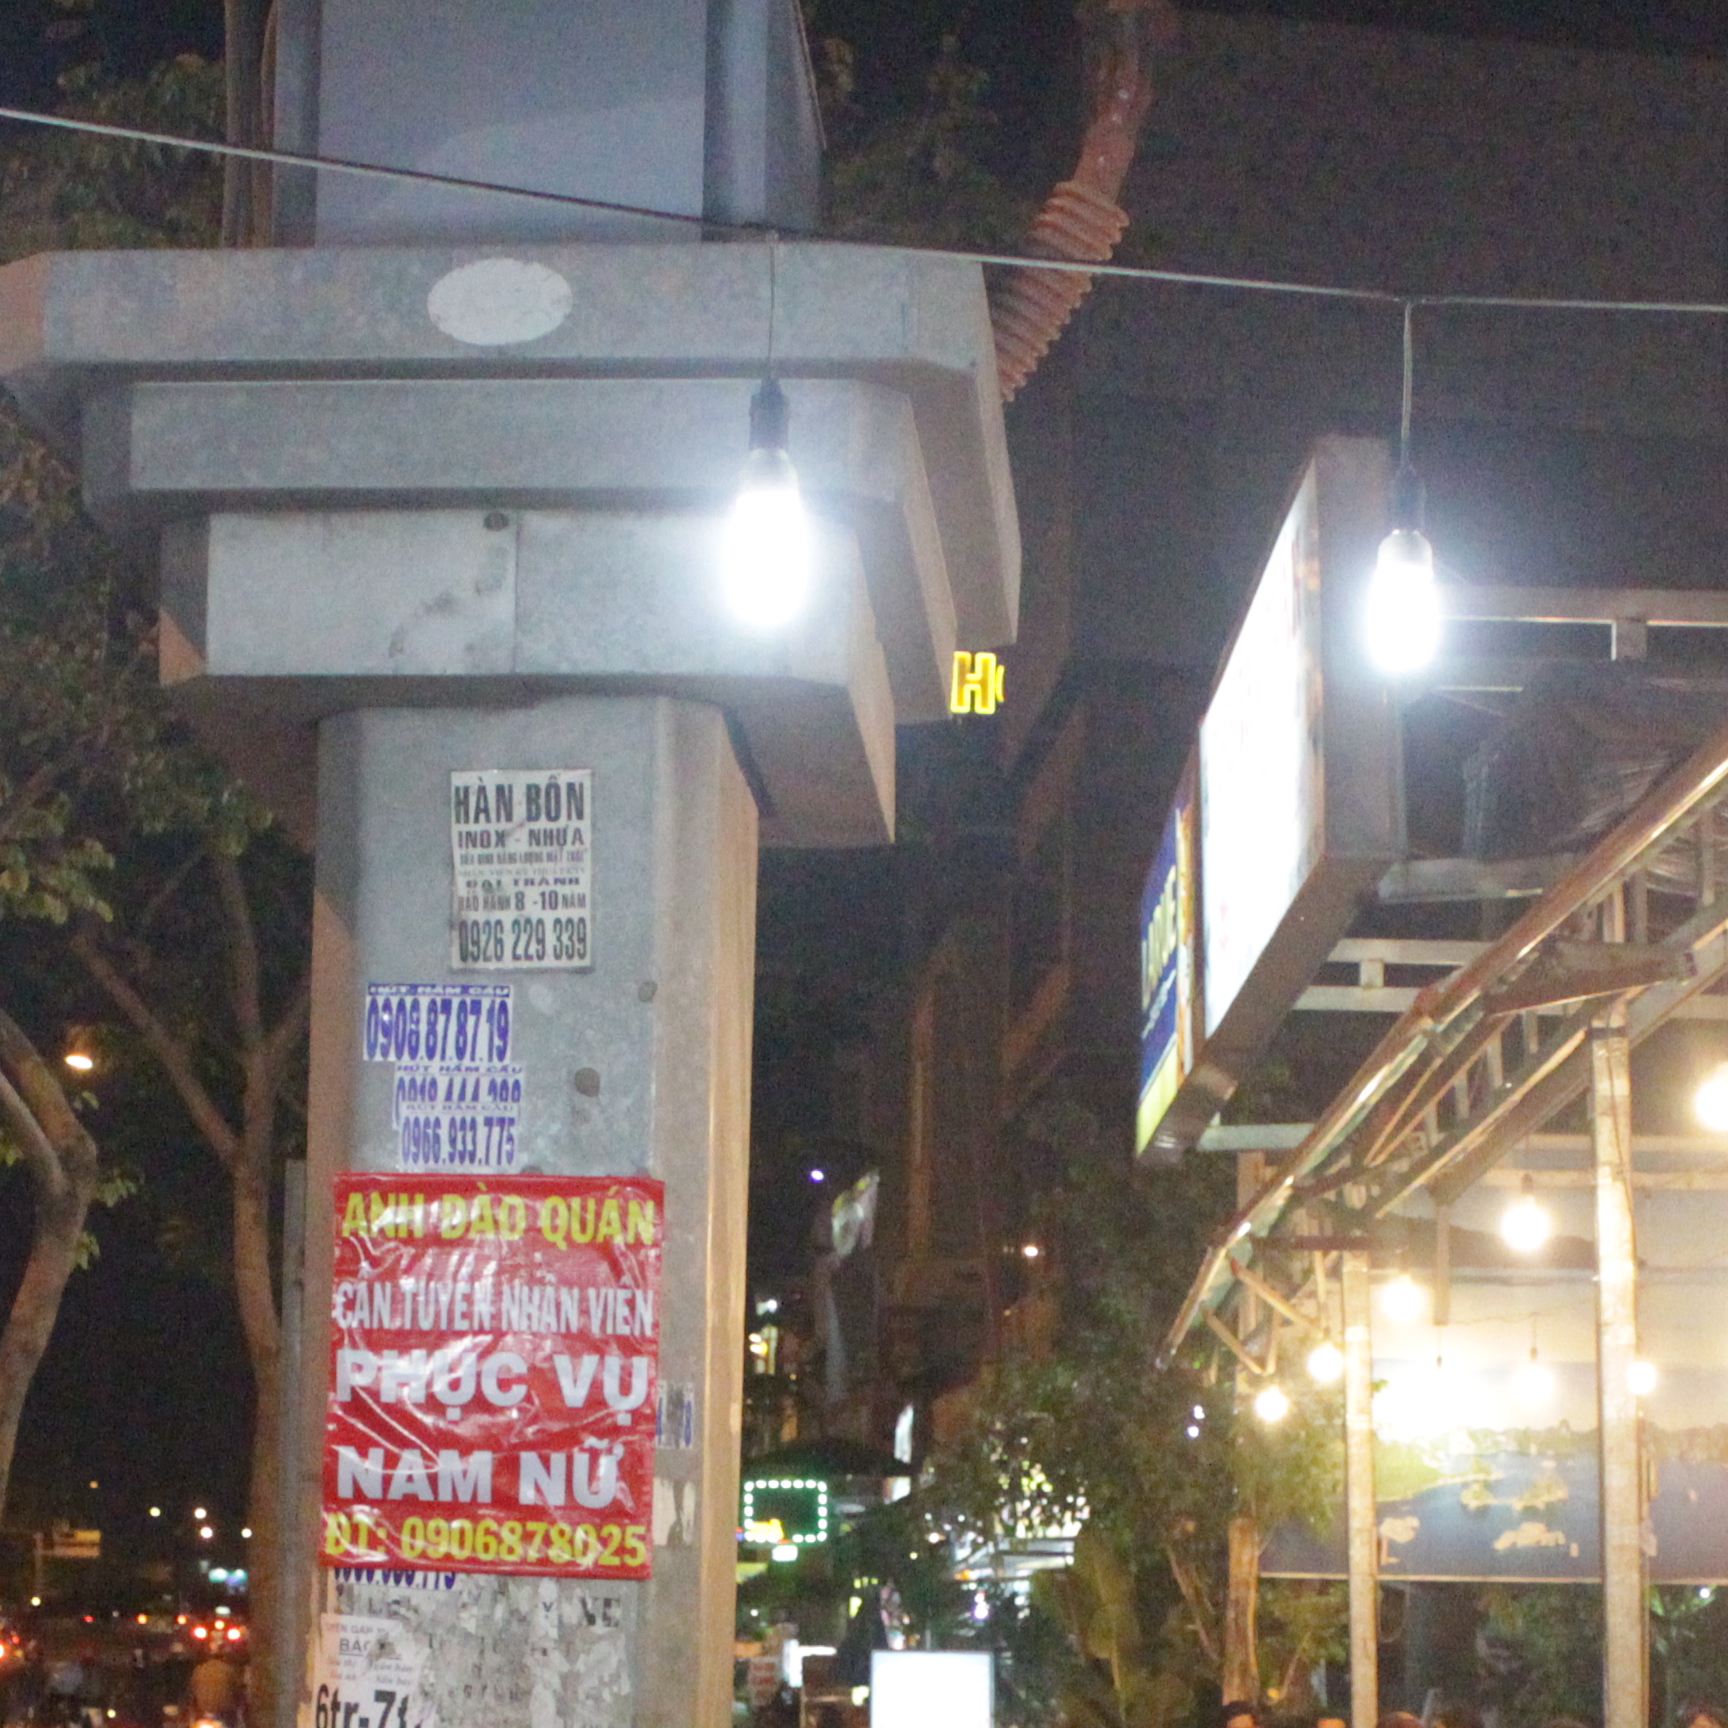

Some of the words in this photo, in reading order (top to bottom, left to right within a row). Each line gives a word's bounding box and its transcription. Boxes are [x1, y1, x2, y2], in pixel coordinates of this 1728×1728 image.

[454, 775, 513, 824] HÀN
[458, 829, 506, 849] INOX
[515, 891, 526, 911] 8
[458, 919, 504, 963] 0926
[512, 918, 545, 962] 229
[553, 917, 586, 961] 339
[402, 1116, 515, 1165] 0966.933.775
[342, 1193, 424, 1239] ANH
[441, 1183, 526, 1240] ĐÀO
[541, 1187, 654, 1249] QUÁN
[501, 1271, 579, 1333] NHÂN
[587, 1276, 654, 1336] VIÊN
[335, 1349, 528, 1421] PHỤC
[554, 1354, 649, 1426] VỤ
[336, 1446, 493, 1503] NAM
[519, 1437, 624, 1508] NỮ
[401, 1516, 647, 1566] 0906878025
